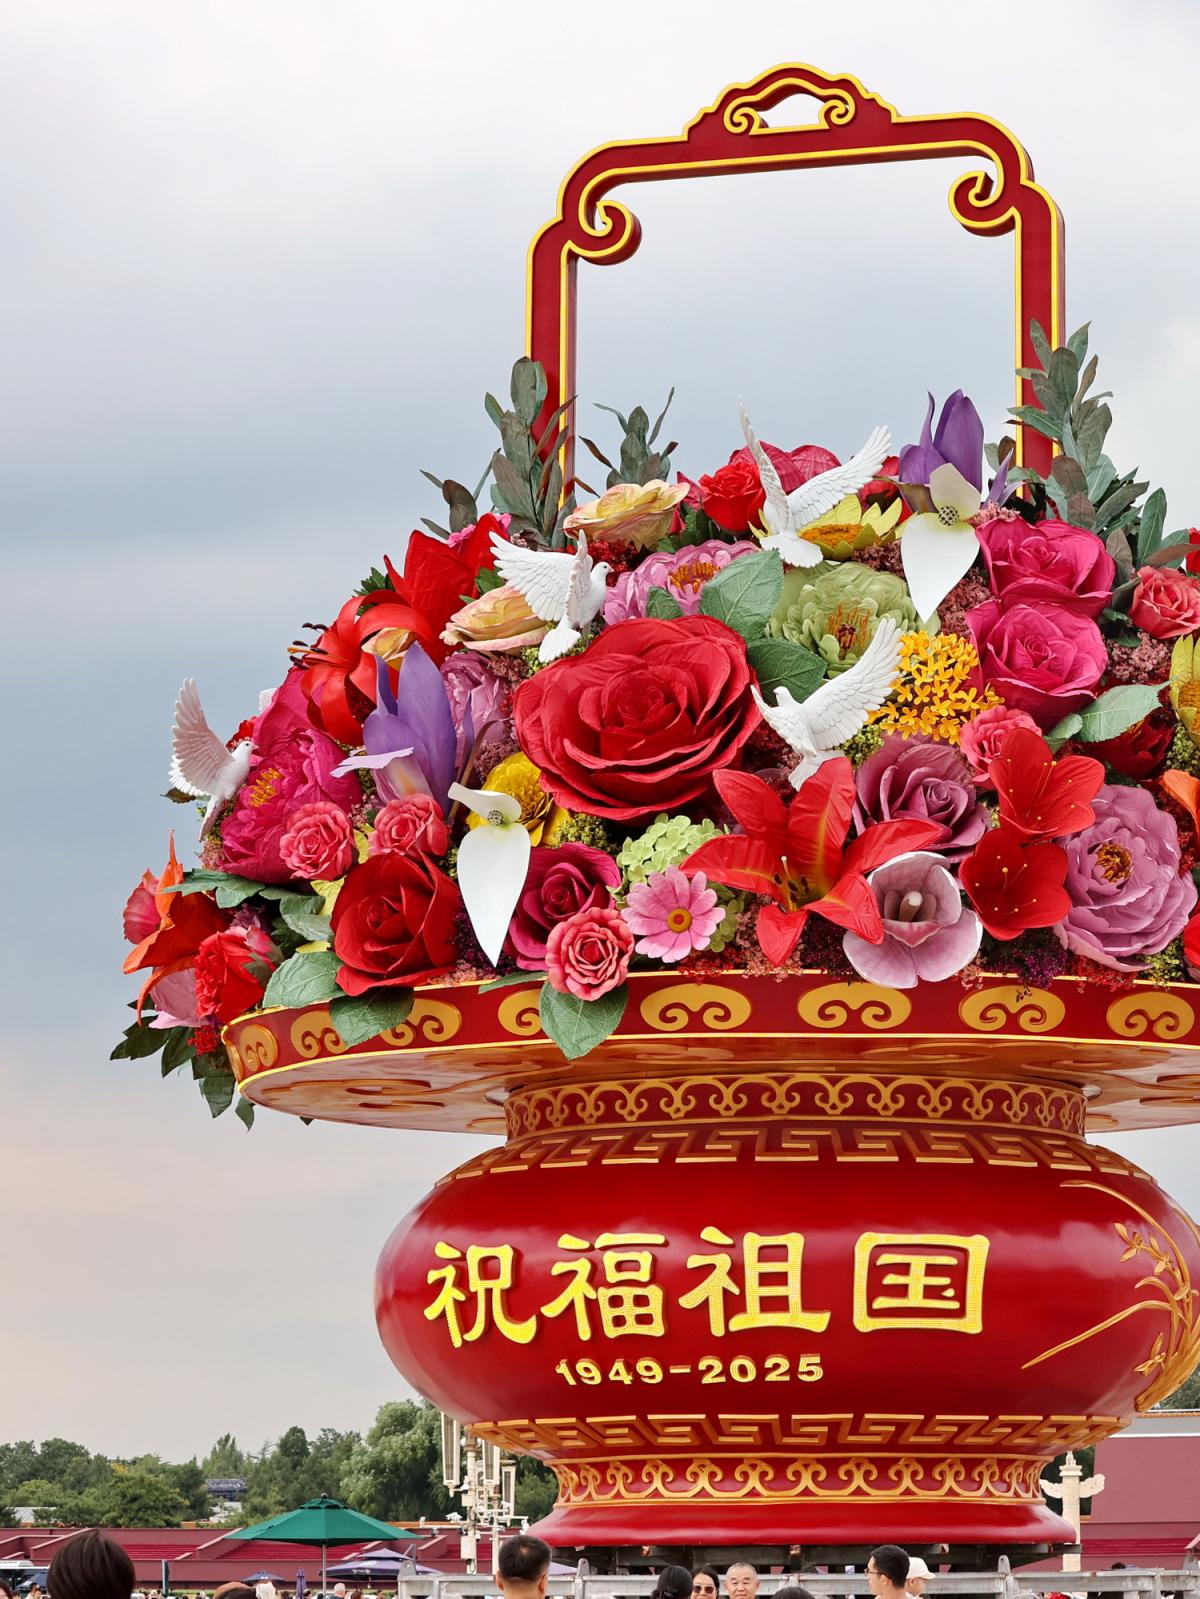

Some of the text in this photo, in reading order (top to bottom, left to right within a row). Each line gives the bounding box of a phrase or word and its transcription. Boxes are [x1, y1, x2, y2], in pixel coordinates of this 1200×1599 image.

[424, 1226, 990, 1347] 祝福祖国
[555, 1353, 825, 1386] 1949-2025
